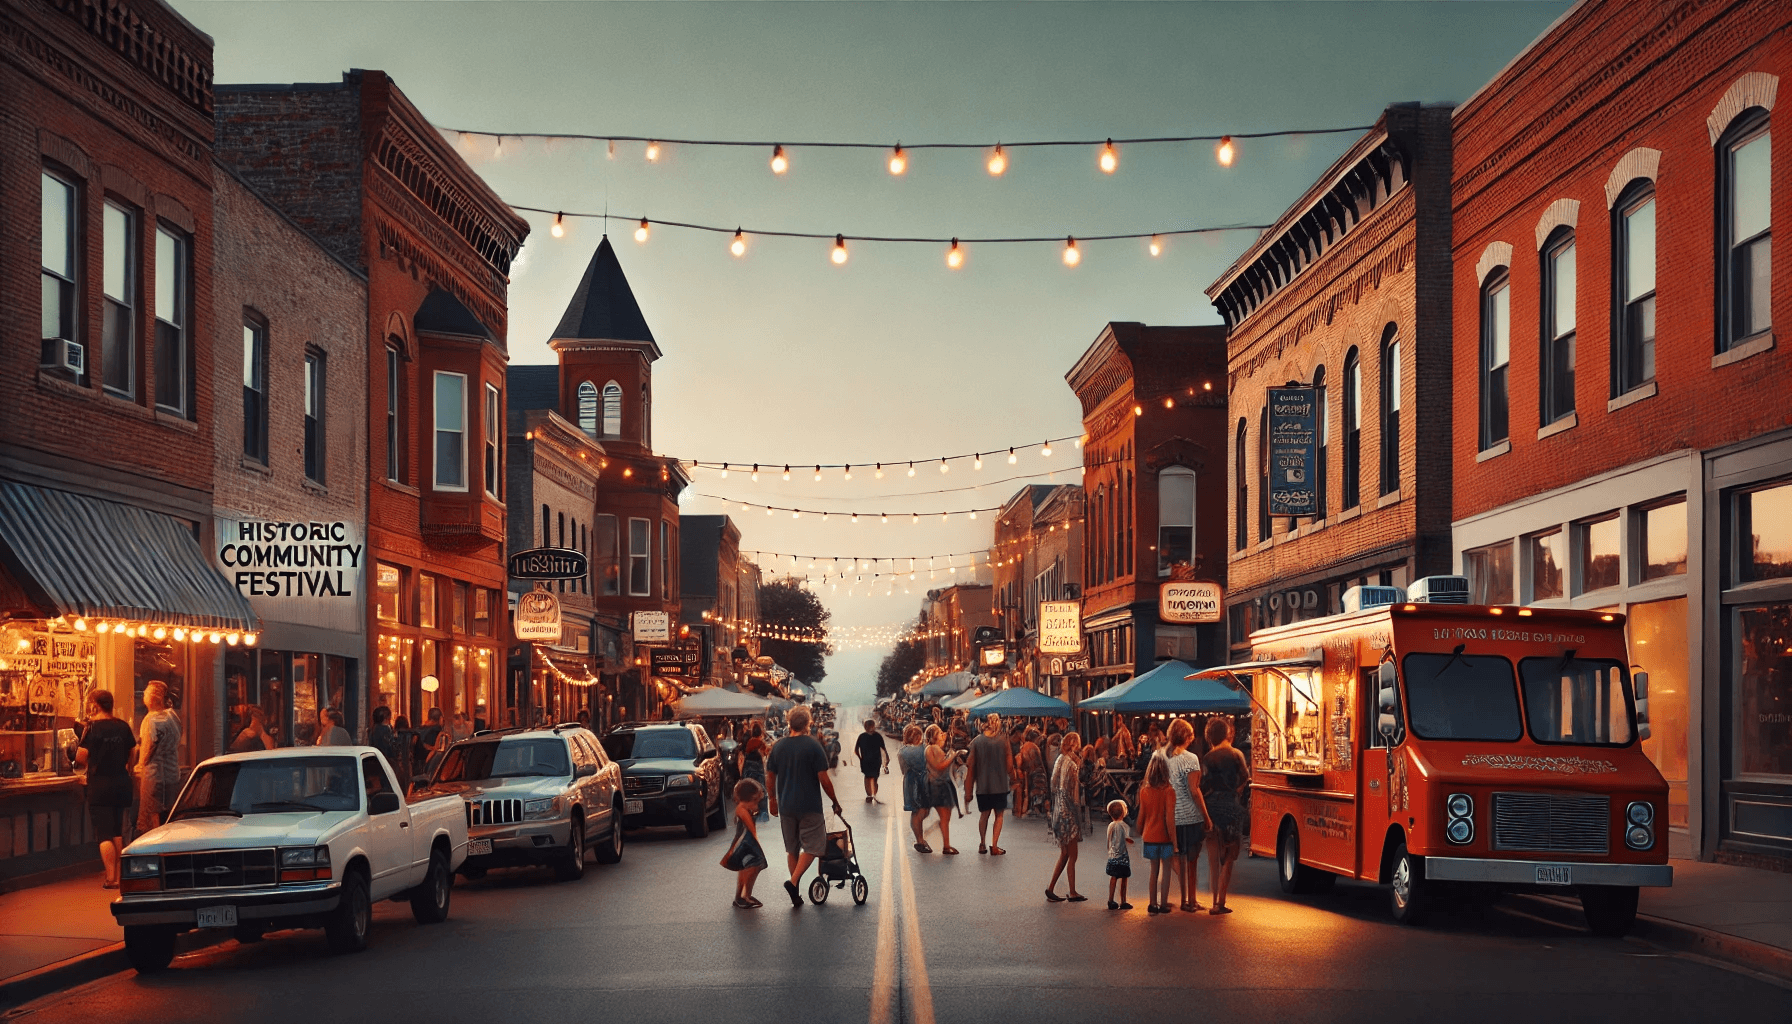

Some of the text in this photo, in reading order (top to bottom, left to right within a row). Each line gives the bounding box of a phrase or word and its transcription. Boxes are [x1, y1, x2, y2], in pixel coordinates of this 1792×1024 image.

[239, 522, 345, 542] HISTORIC
[220, 544, 362, 567] COMMUNITY
[236, 570, 351, 597] FESTIVAL
